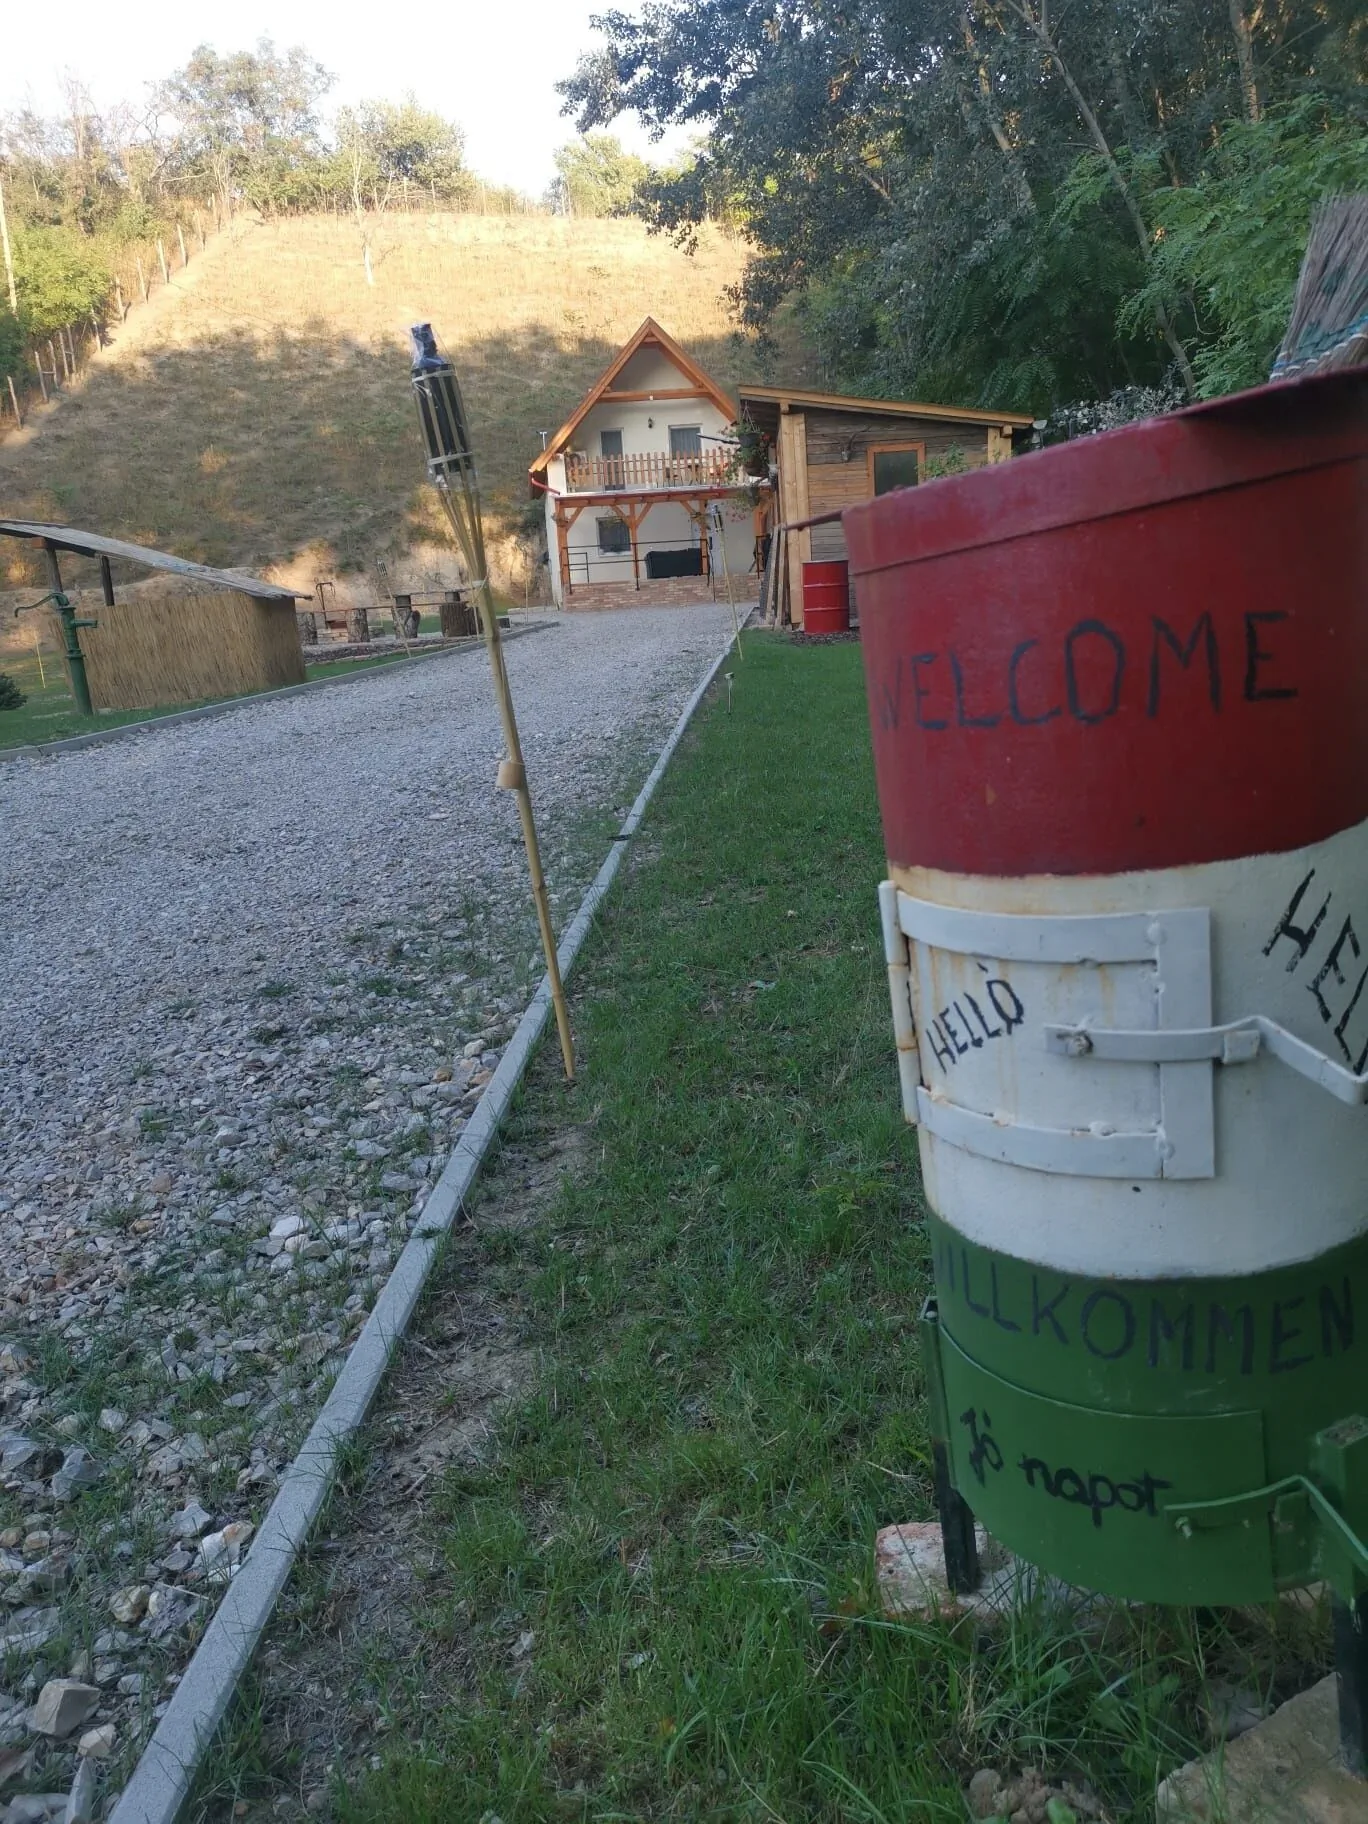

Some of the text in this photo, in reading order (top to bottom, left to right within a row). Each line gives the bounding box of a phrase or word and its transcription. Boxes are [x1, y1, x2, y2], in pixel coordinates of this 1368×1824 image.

[875, 609, 1298, 732] WELCOME
[938, 1240, 1355, 1376] ILLKOMMEN
[1016, 1452, 1174, 1529] napot
